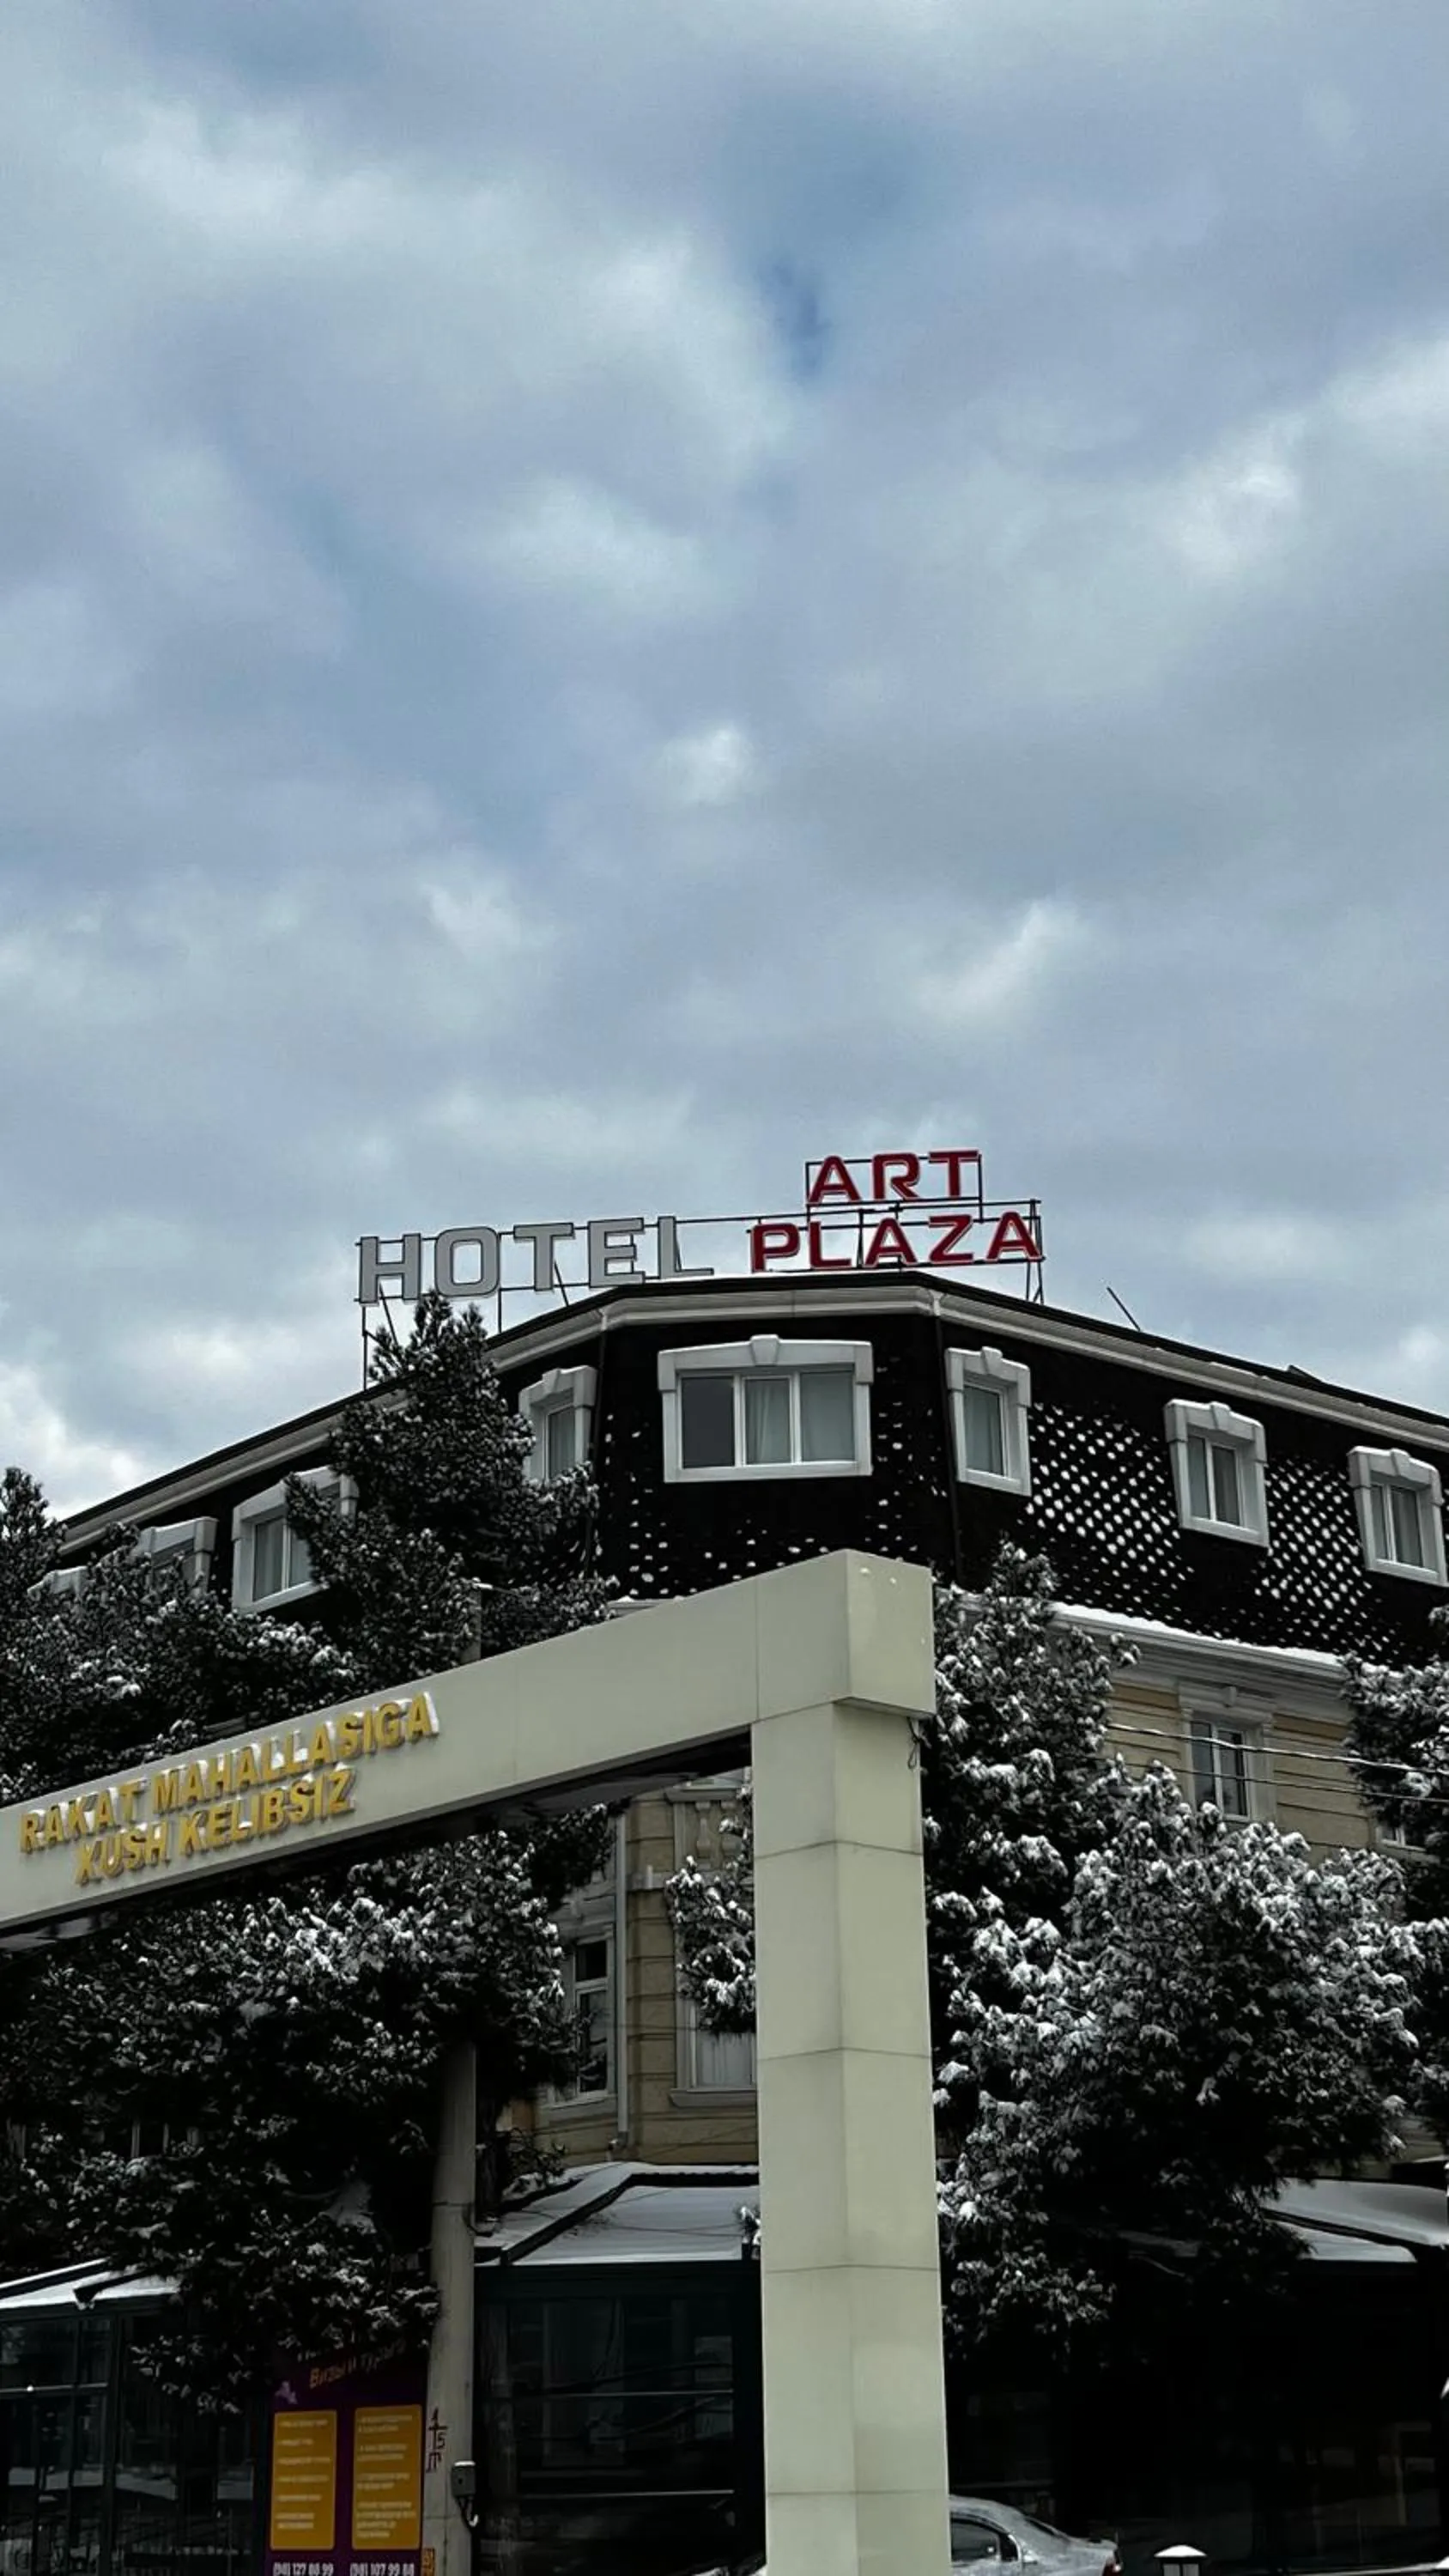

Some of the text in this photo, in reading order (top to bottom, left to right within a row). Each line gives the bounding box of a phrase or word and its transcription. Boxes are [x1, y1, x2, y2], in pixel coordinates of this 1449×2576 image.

[809, 1150, 979, 1206] ART
[359, 1211, 1043, 1304] HOTEL PLAZA
[19, 1691, 440, 1853] RAKAT MAHALLASIGA
[179, 1763, 356, 1856] KELIBSIZ
